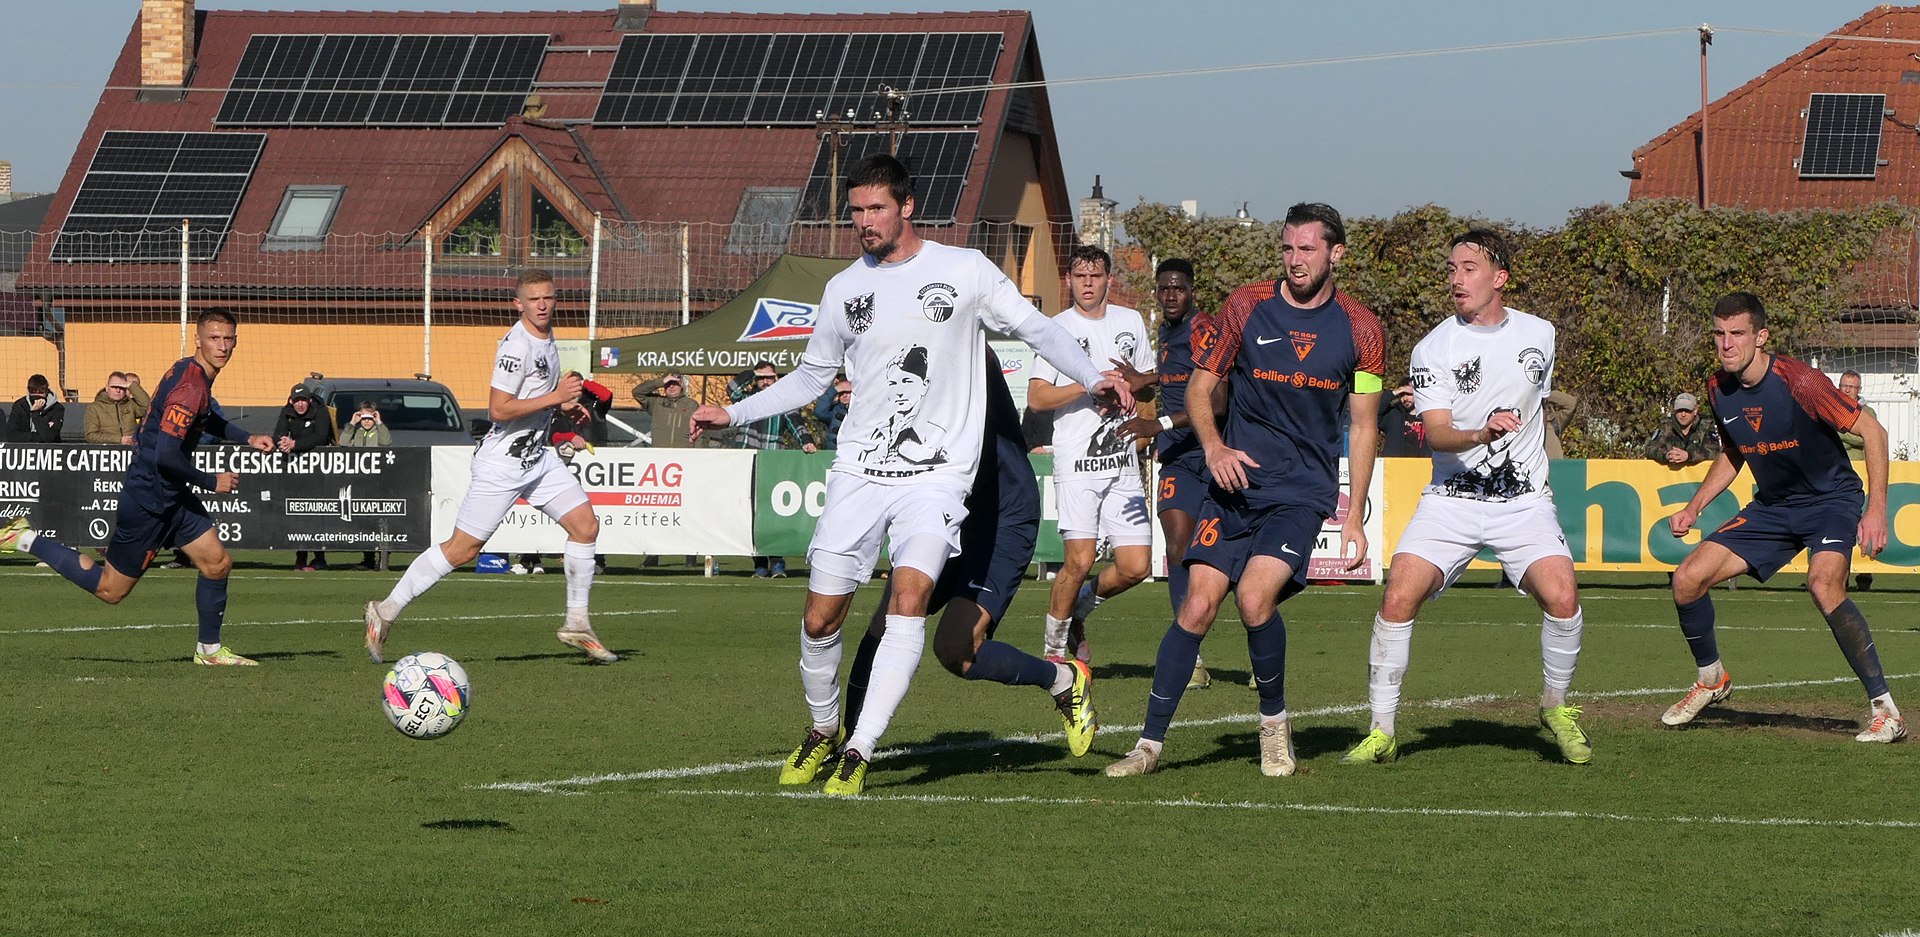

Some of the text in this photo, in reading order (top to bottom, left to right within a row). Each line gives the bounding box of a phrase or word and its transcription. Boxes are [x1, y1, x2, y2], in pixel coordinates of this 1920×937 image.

[637, 347, 805, 367] KRAJSKÉ VOJENSKÉ V
[1253, 368, 1290, 383] Sellier
[1308, 376, 1340, 390] Bellot
[167, 409, 187, 428] NL
[1769, 439, 1800, 451] Bellot
[191, 445, 227, 474] ELÉ
[229, 445, 283, 474] ČESKÉ
[287, 451, 382, 474] REPUBLICE
[637, 462, 684, 487] AG
[222, 498, 252, 513] NÁS.
[289, 501, 338, 512] RESTAURACE
[352, 502, 359, 512] U
[624, 494, 681, 505] BOHEMIA
[501, 510, 559, 528] Mysl
[623, 510, 681, 527] zítřek
[218, 522, 242, 542] 83
[287, 531, 408, 543] www.cateringsindelar.cz
[1190, 517, 1220, 548] 26
[404, 696, 435, 735] SELECT
